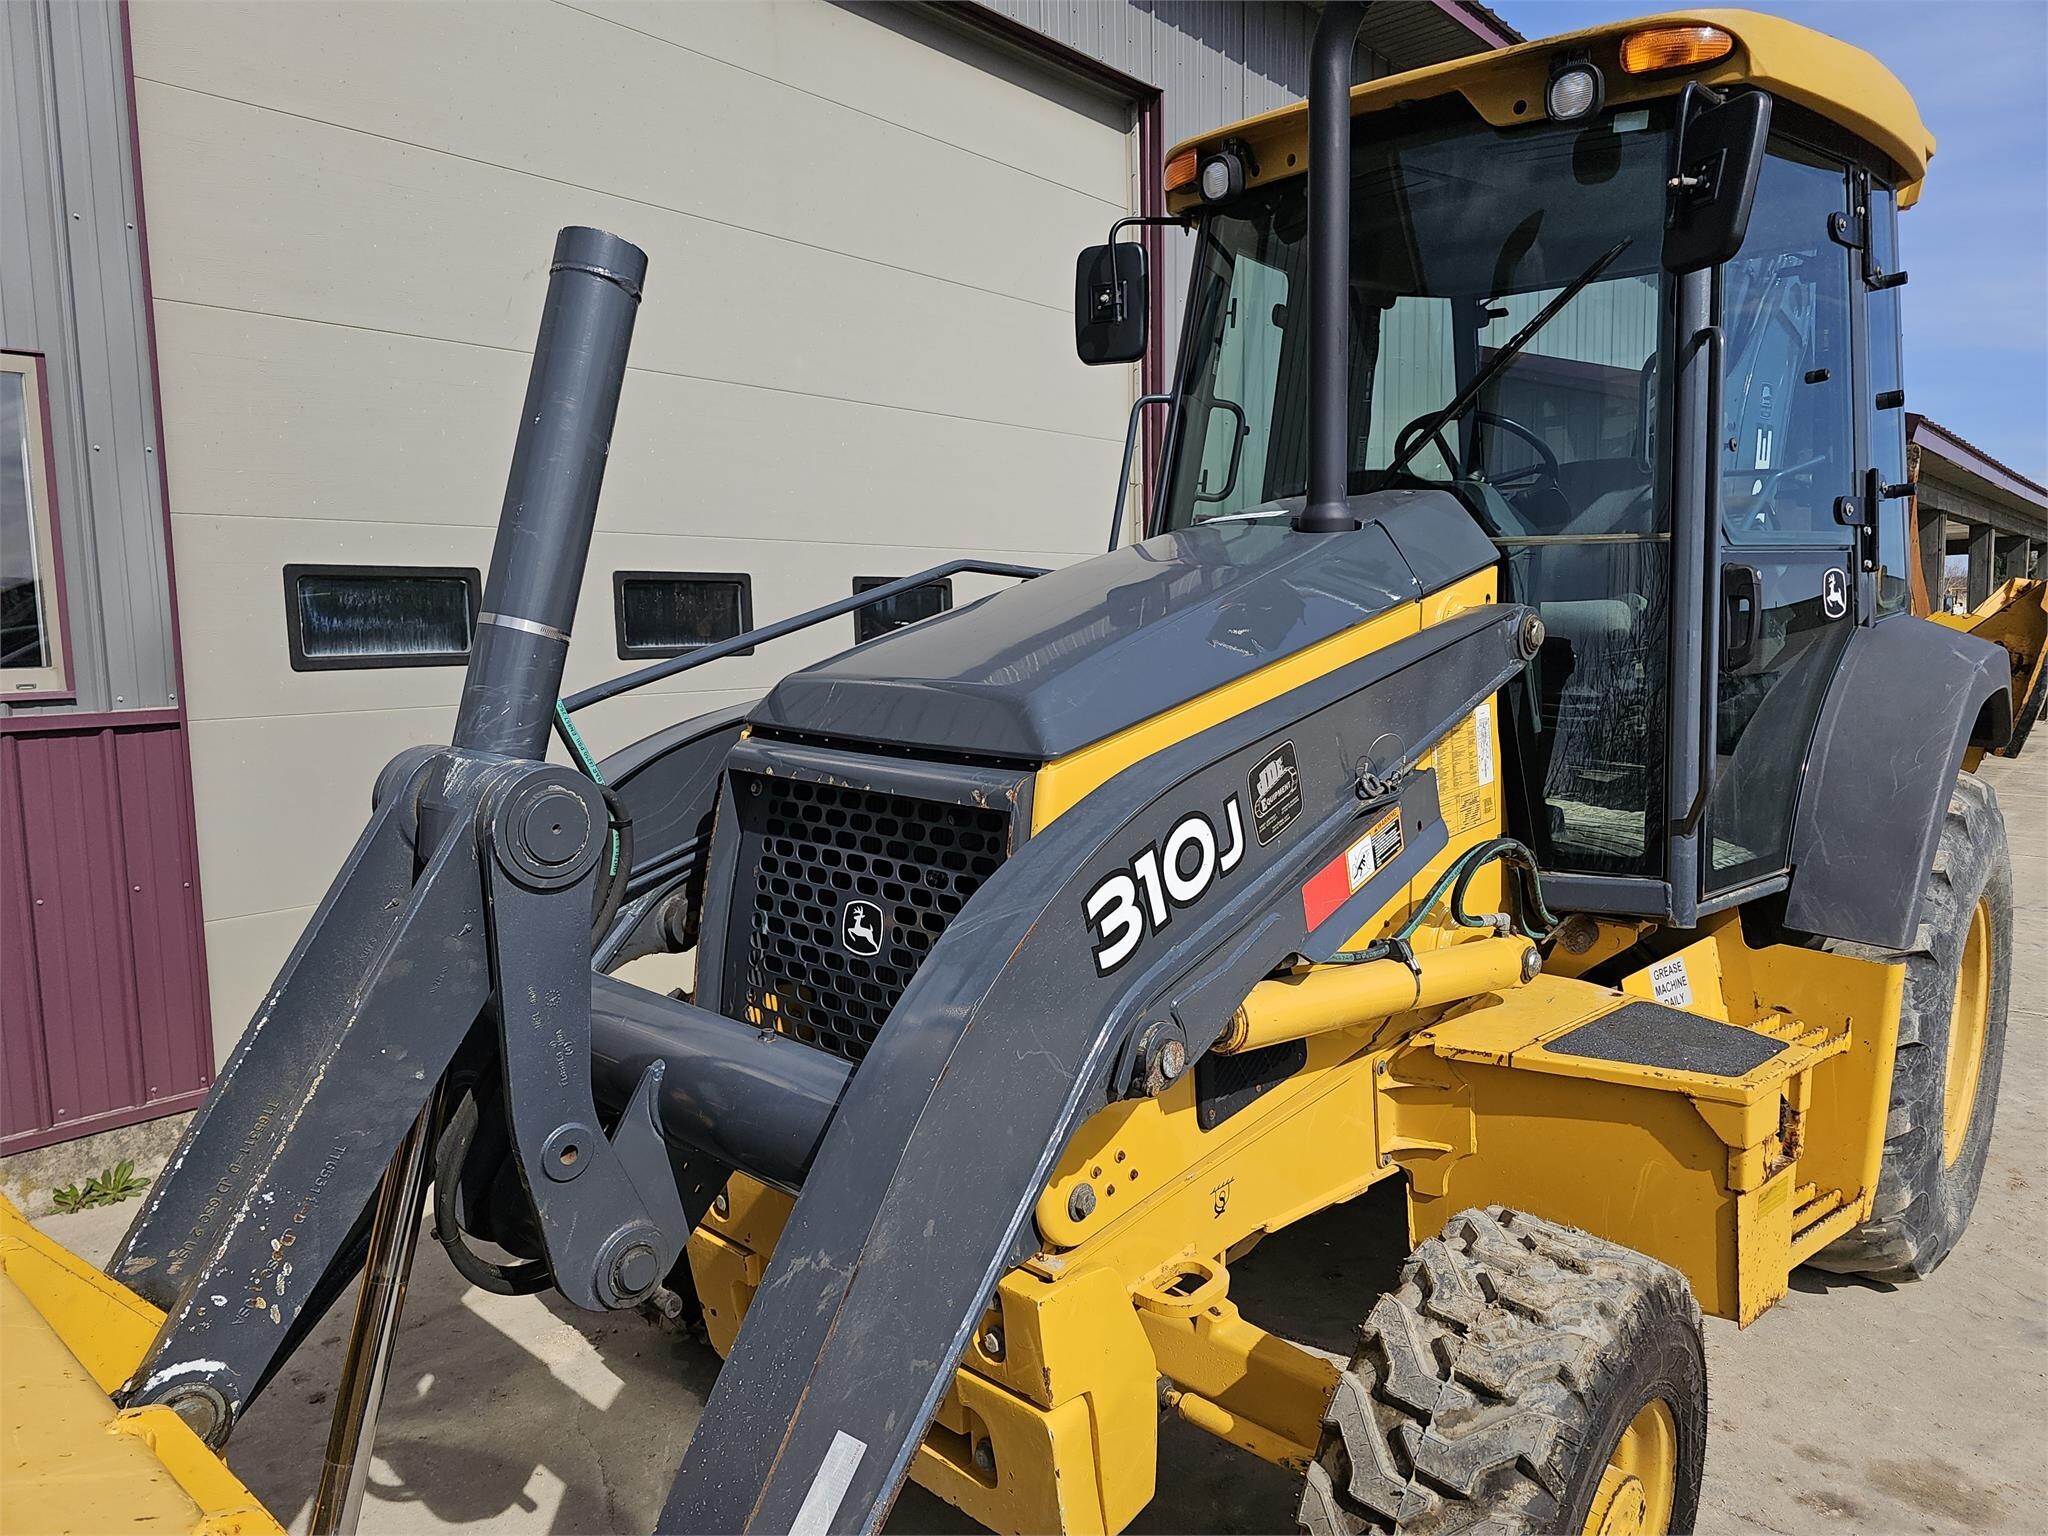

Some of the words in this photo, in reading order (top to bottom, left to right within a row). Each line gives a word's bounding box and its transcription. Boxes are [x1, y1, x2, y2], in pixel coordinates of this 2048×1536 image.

[1262, 781, 1290, 811] EQUIPMENT
[1087, 798, 1244, 970] 310J
[1653, 961, 1682, 980] GREASE
[1655, 975, 1687, 997] MACHINE
[1664, 992, 1685, 1006] DAILY
